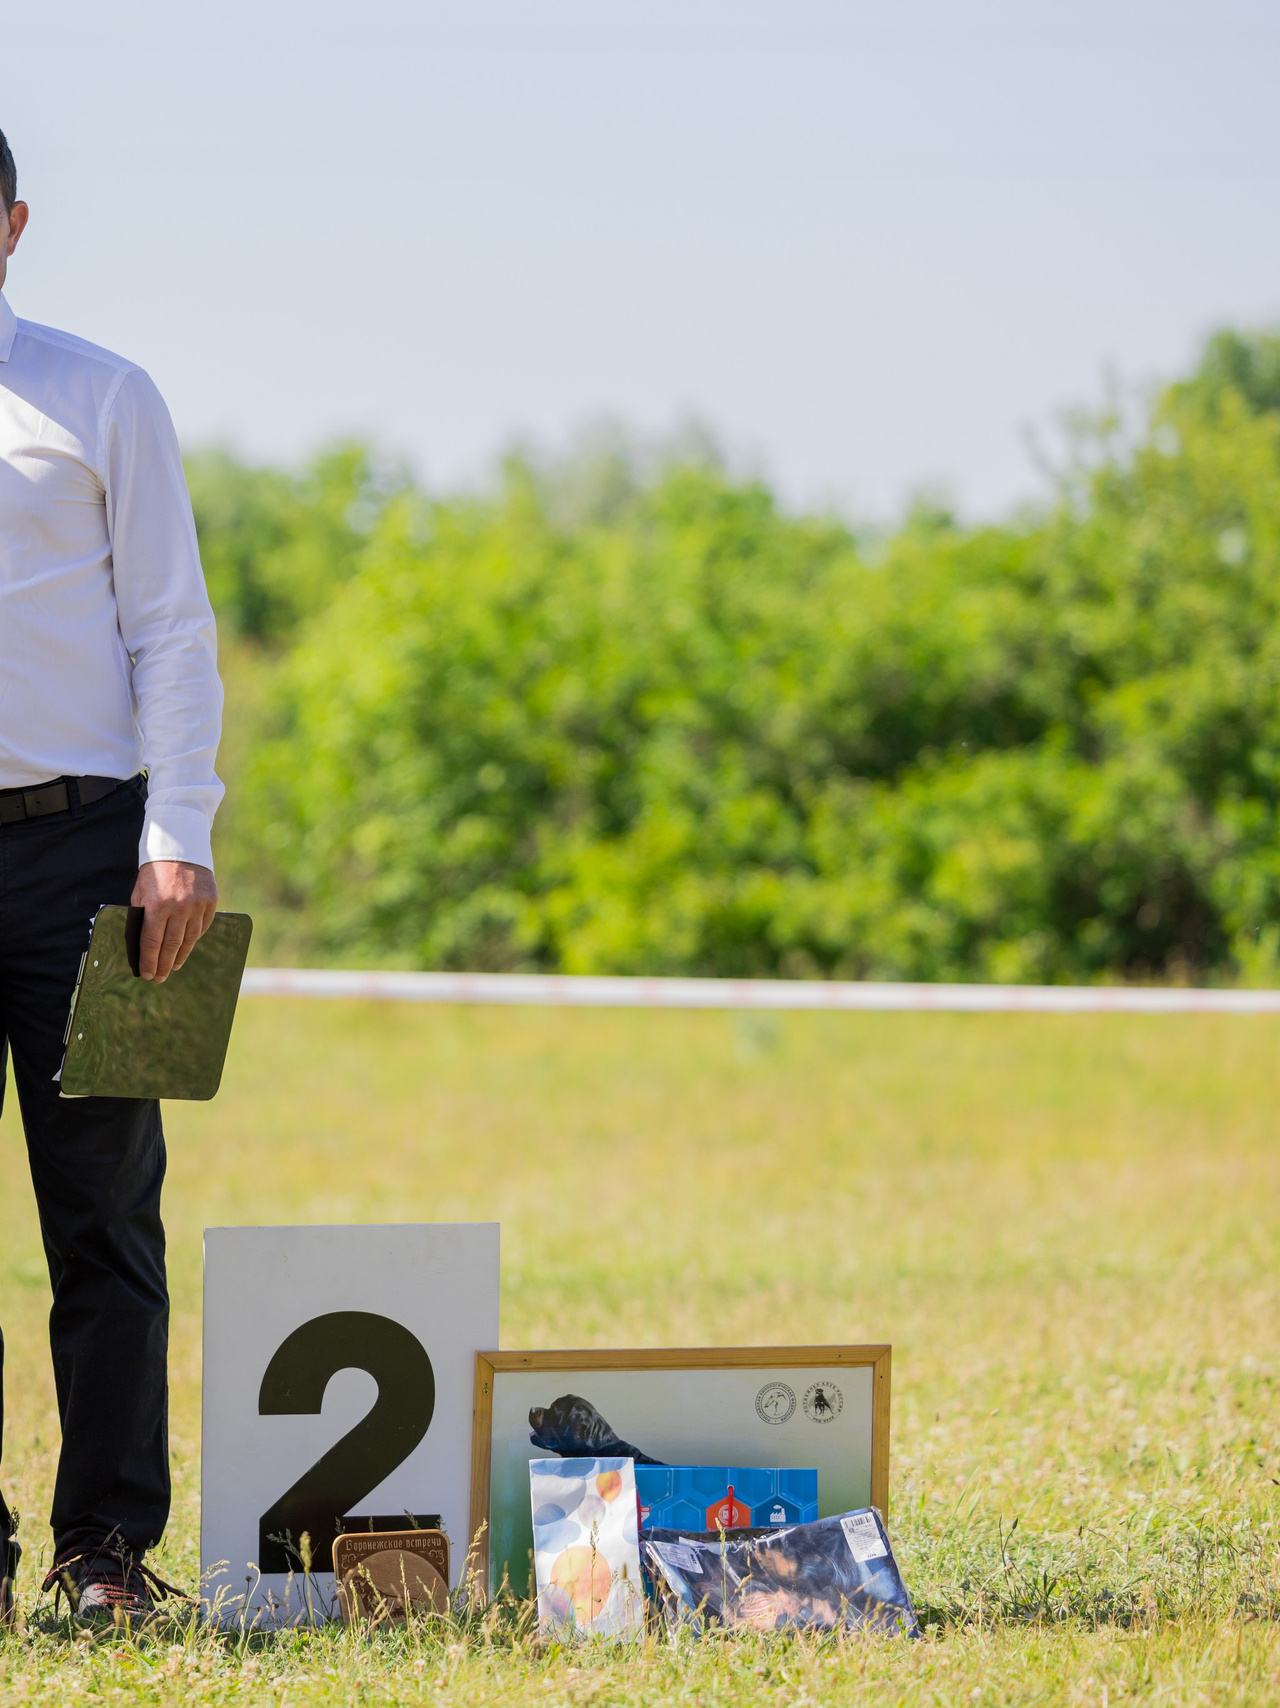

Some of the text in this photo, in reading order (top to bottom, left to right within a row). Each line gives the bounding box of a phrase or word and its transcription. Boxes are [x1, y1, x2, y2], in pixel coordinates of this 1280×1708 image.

[258, 1311, 441, 1574] 2
[345, 1537, 442, 1552] Воронежские встречи
